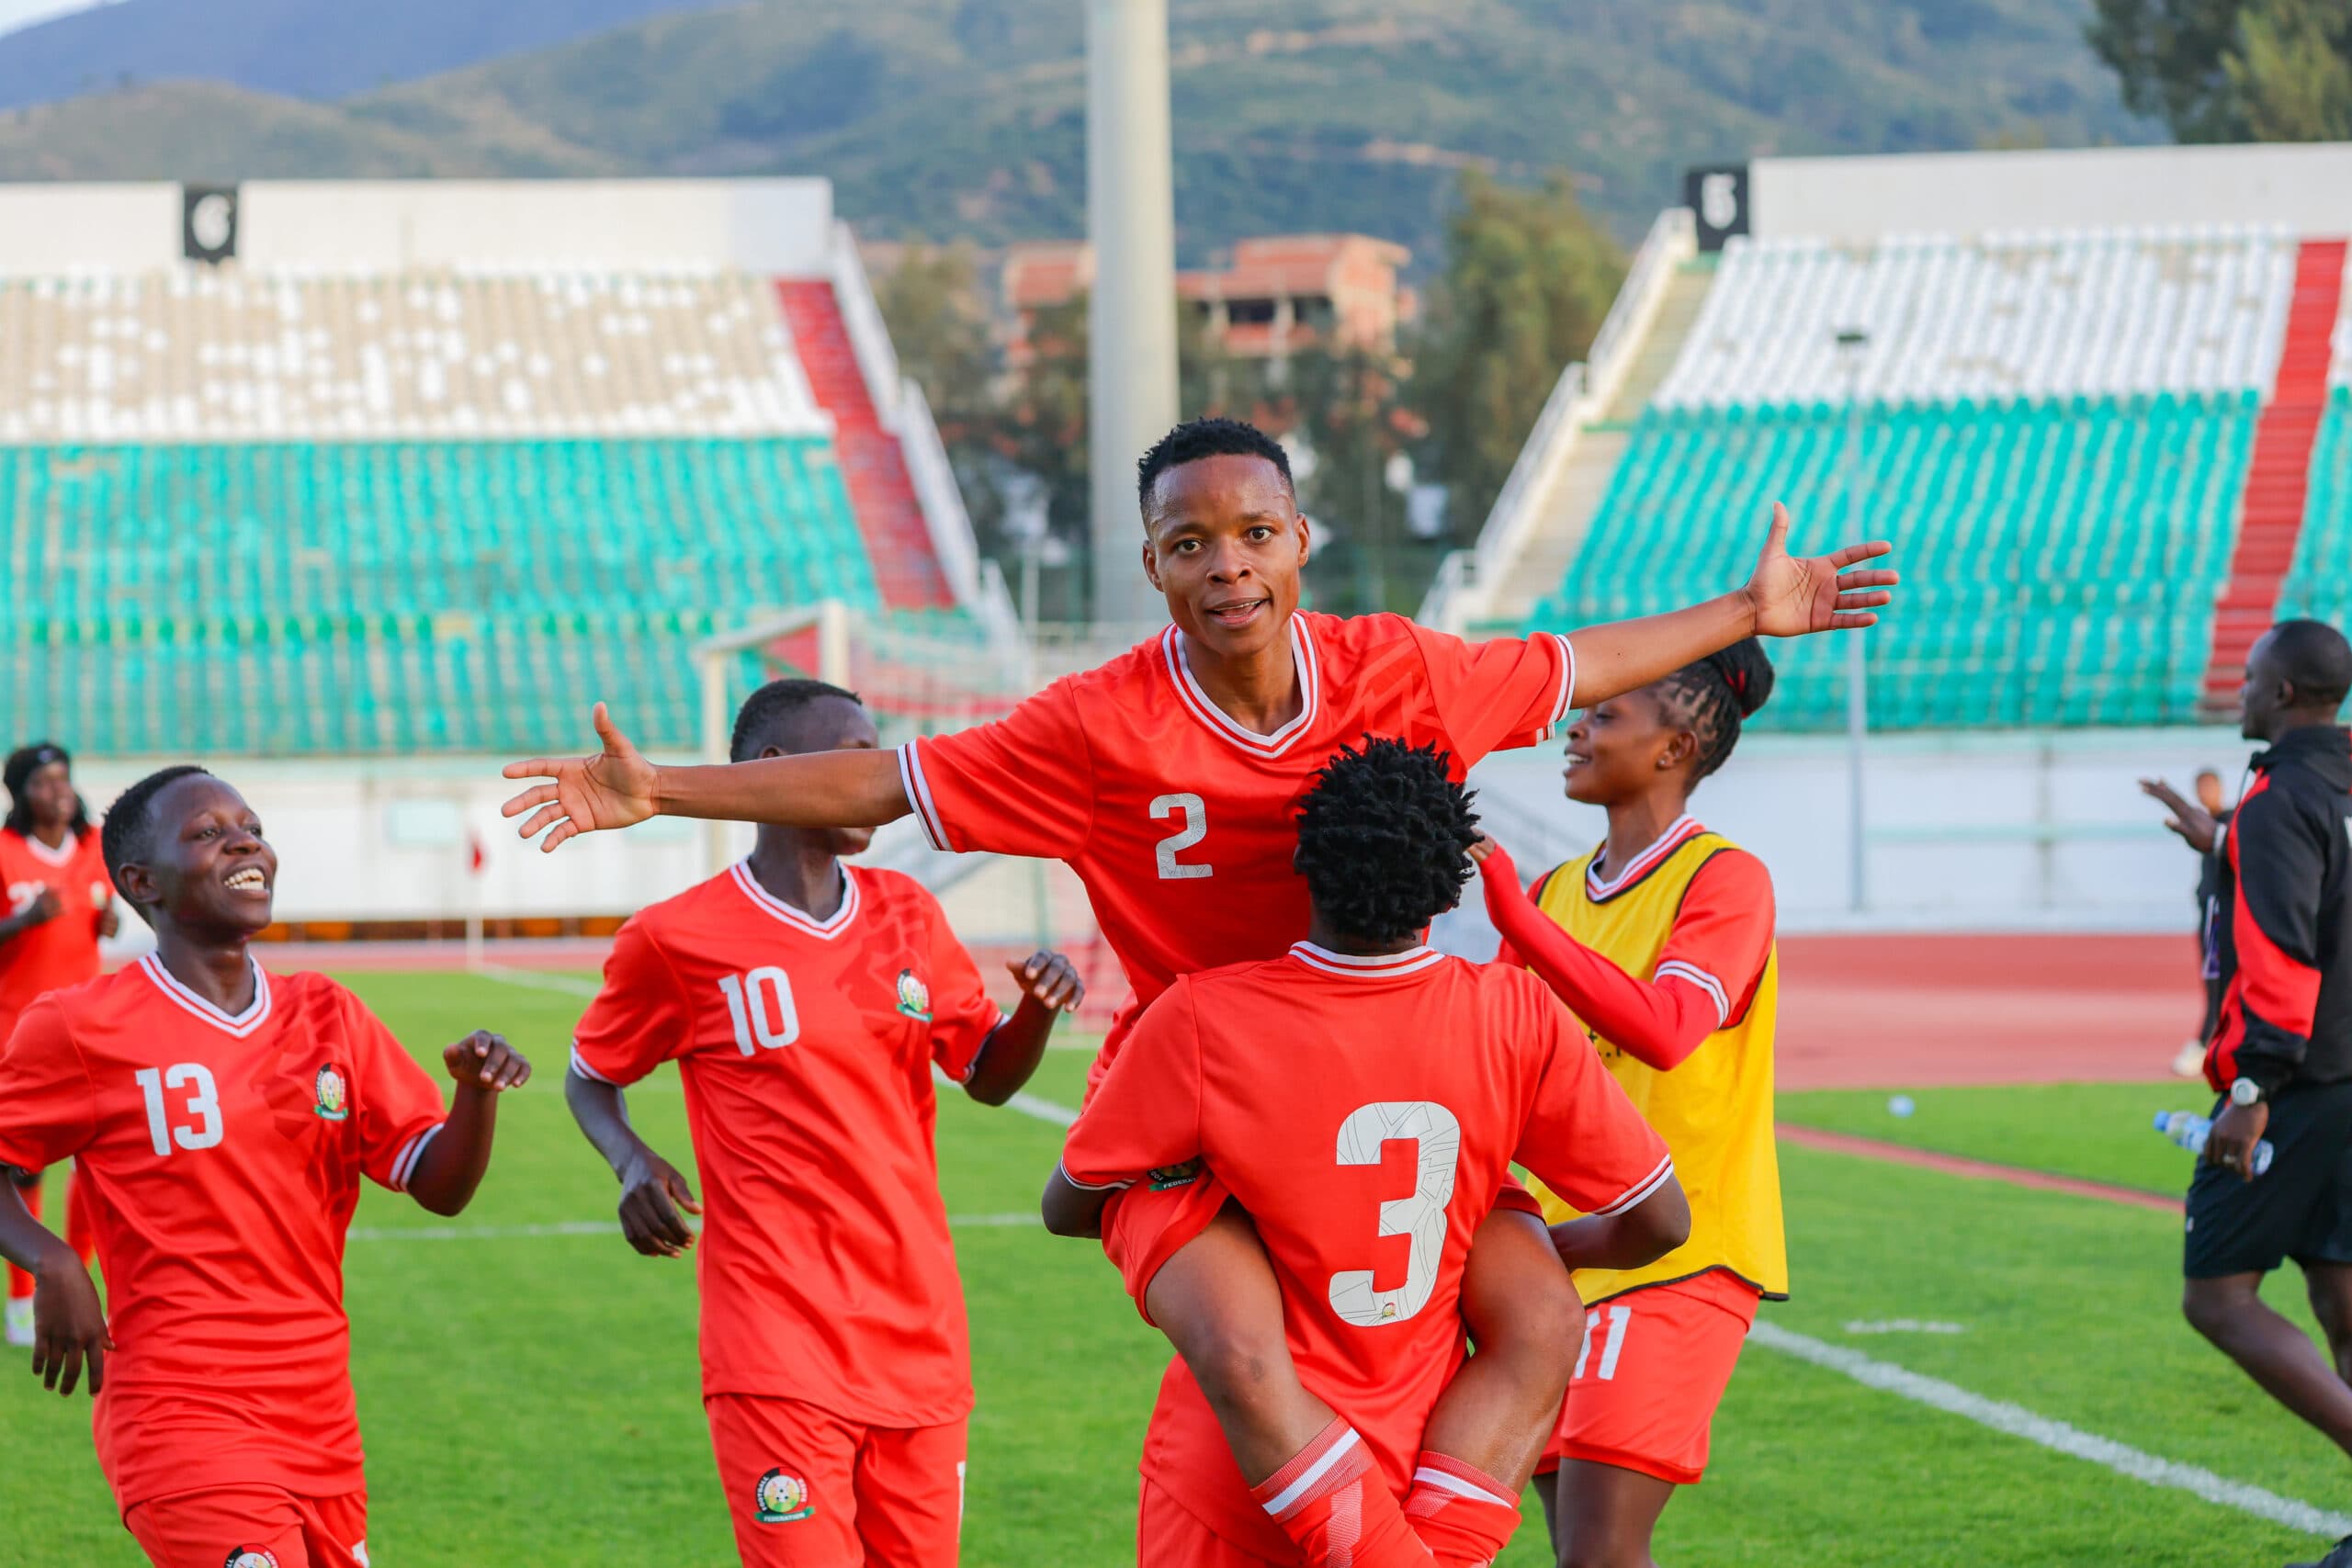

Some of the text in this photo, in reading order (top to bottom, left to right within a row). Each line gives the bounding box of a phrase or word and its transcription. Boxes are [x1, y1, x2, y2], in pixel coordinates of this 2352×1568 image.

[1149, 793, 1213, 879] 2
[718, 965, 799, 1056] 10
[135, 1062, 223, 1156] 13
[1329, 1101, 1461, 1326] 3
